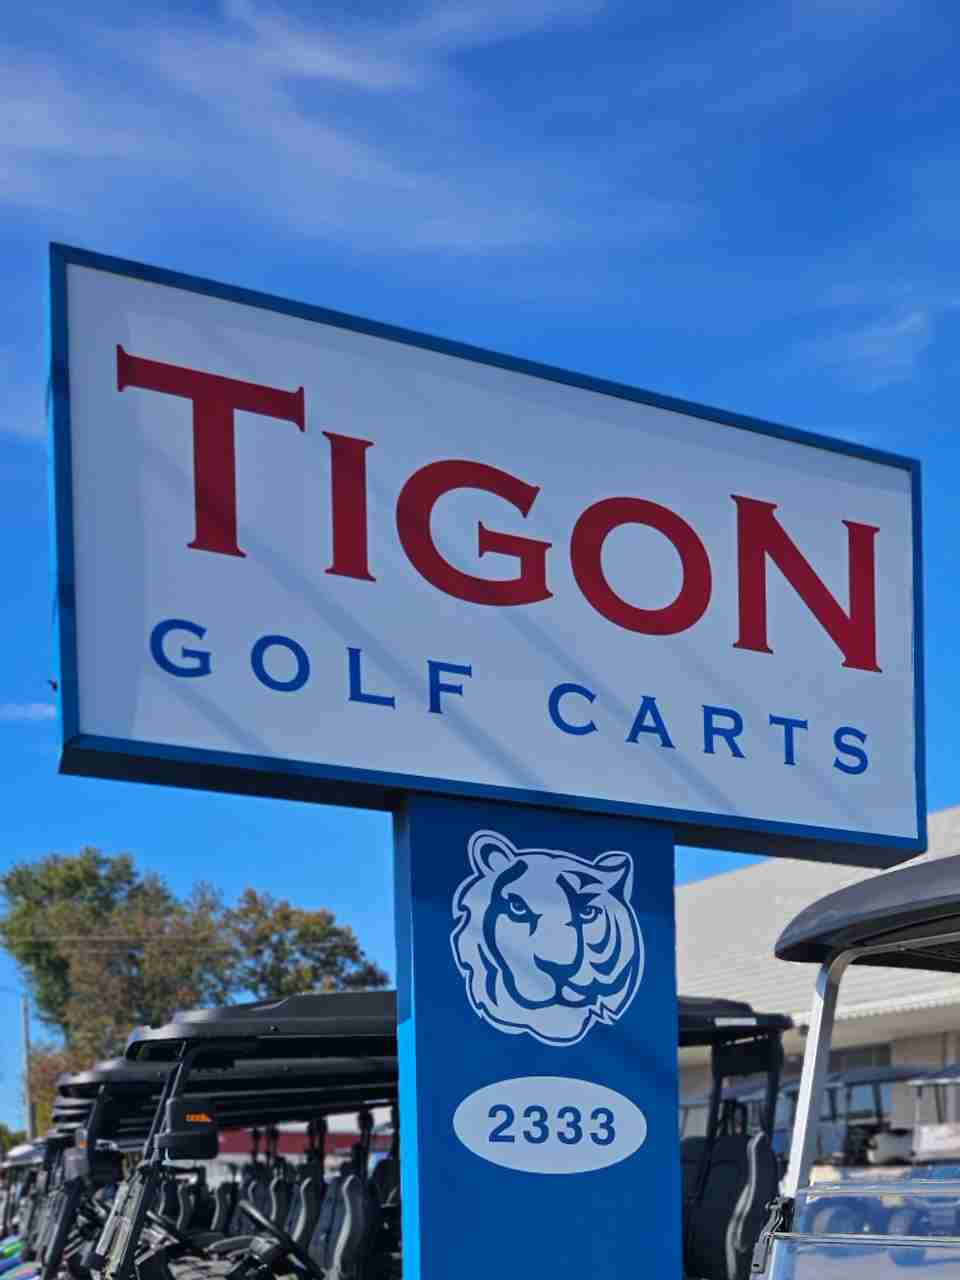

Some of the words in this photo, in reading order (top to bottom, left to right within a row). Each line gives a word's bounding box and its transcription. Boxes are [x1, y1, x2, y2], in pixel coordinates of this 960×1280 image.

[115, 343, 884, 674] TIGON
[149, 617, 473, 715] GOLF
[547, 681, 870, 777] CARTS
[487, 1103, 617, 1147] 2333
